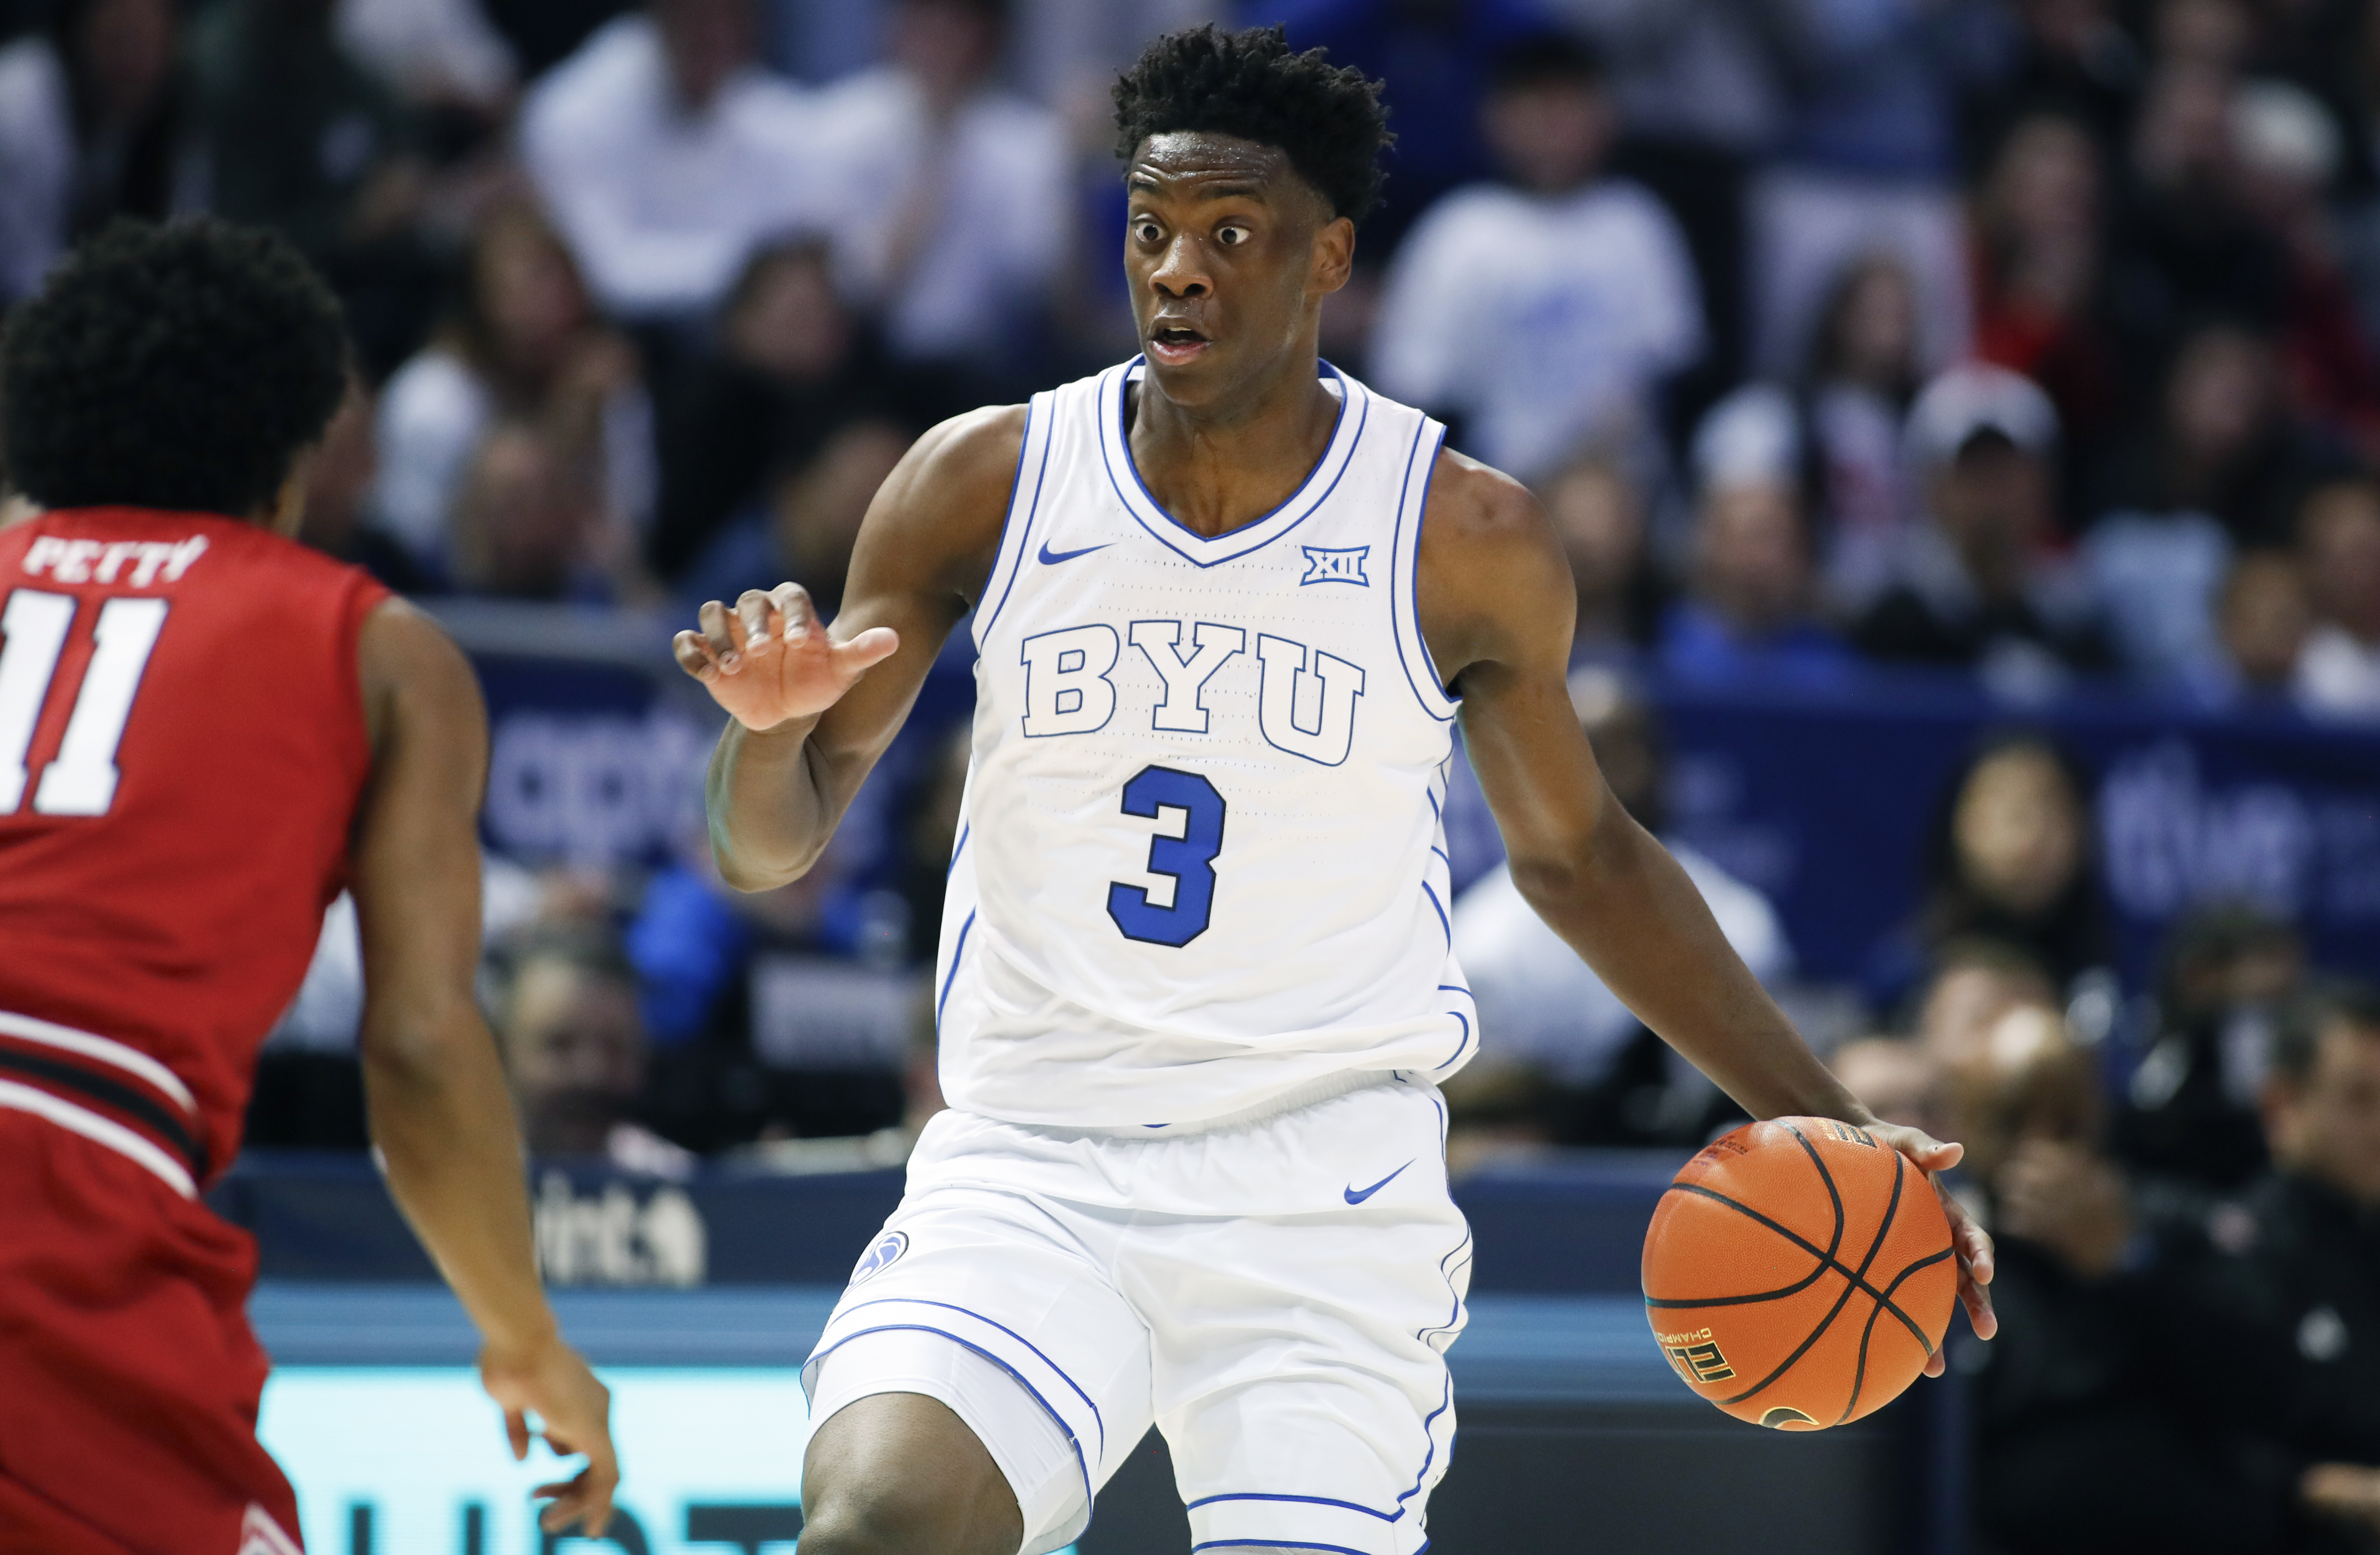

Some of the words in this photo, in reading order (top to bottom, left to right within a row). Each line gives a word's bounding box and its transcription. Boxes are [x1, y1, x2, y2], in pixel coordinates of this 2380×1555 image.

[22, 534, 210, 589] PETTY
[0, 587, 171, 817] 11
[1021, 620, 1366, 767] BYU
[1106, 764, 1226, 948] 3
[1656, 1327, 1713, 1344] CHAMPIO
